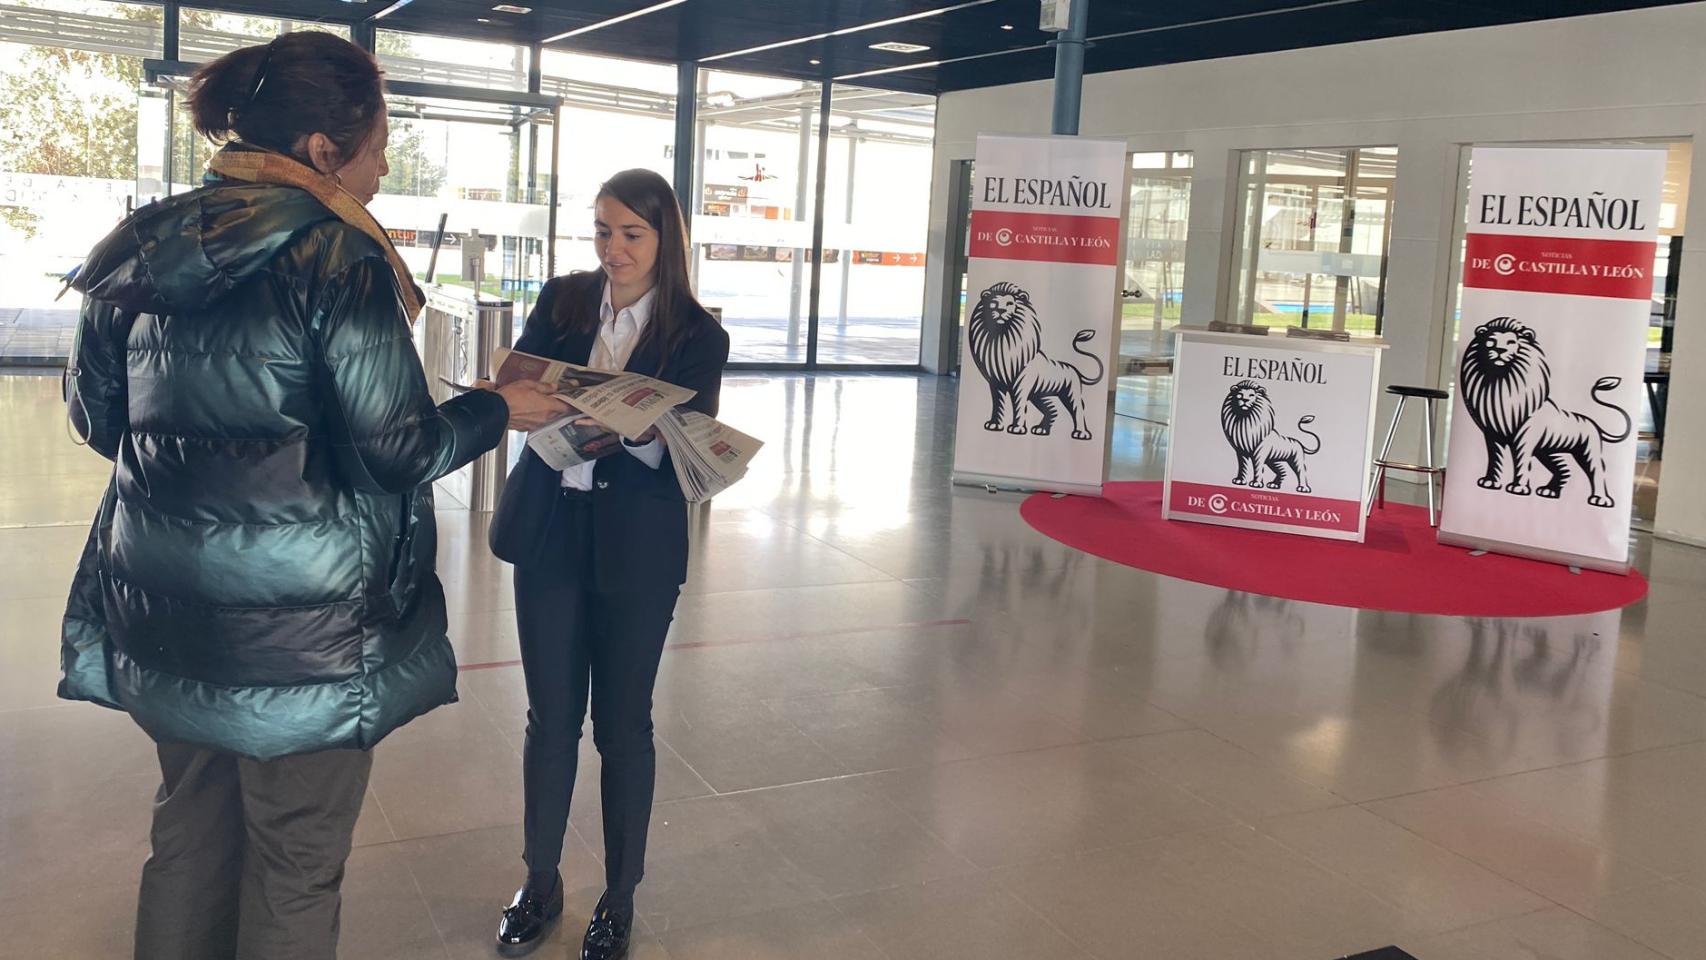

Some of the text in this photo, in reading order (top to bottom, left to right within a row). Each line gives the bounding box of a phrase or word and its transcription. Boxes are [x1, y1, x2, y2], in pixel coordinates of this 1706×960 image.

[984, 175, 1111, 209] EL ESPAÑOL
[1480, 191, 1646, 231] EL ESPAÑOL
[978, 231, 1111, 248] DE CASTILLA Y LEÓN
[1472, 258, 1644, 278] DE CASTILLA Y LEÓN
[1541, 251, 1573, 259] NOTICIAS
[1222, 356, 1327, 385] EL ESPAÑOL
[1187, 496, 1341, 523] DE CASTILLA Y LEÓN
